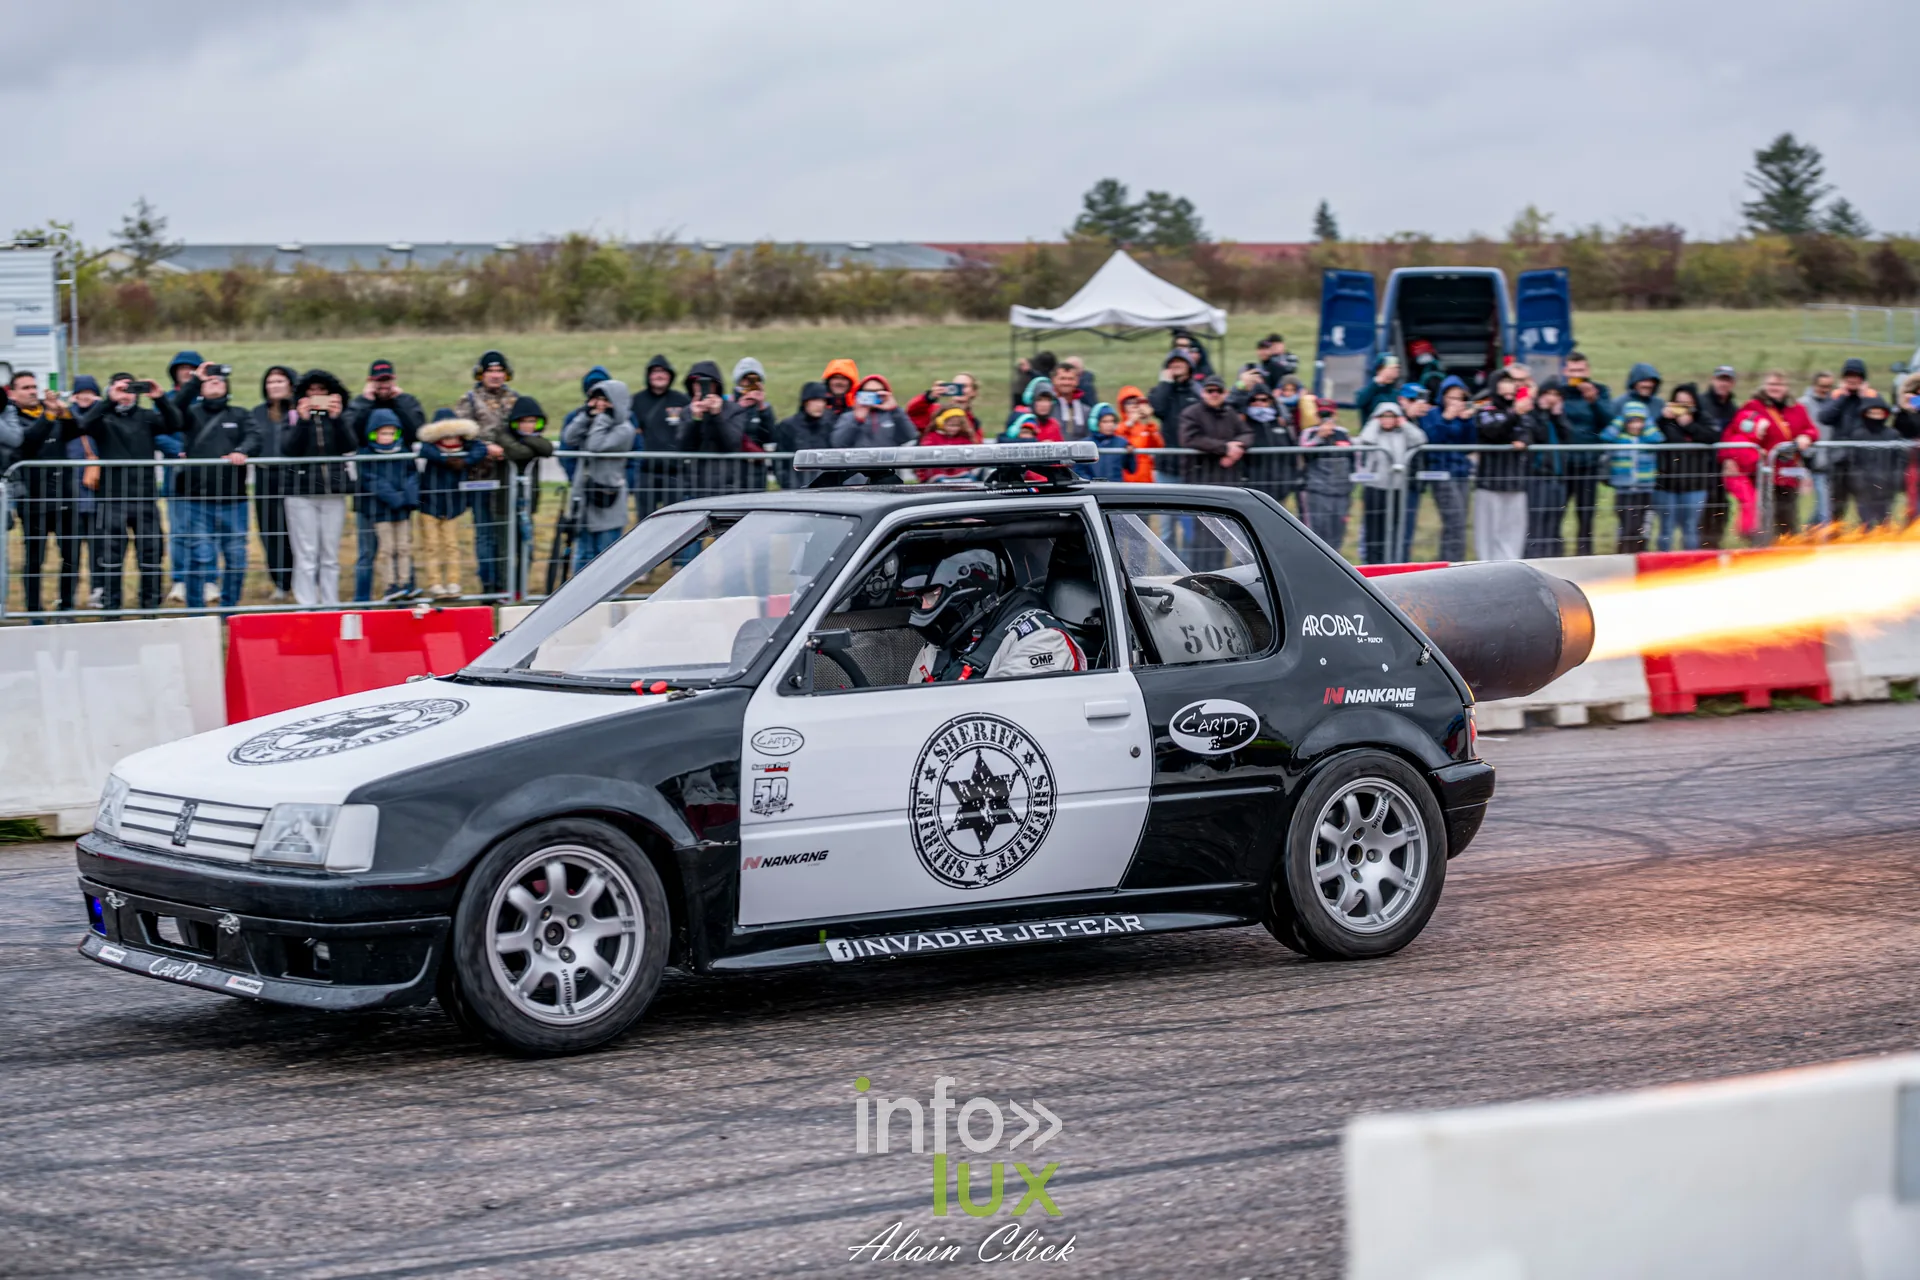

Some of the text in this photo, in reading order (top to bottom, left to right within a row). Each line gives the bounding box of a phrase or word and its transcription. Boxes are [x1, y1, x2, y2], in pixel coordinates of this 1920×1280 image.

[1179, 624, 1242, 655] 508
[1302, 614, 1368, 636] AROBAZ
[1030, 654, 1053, 666] OMP
[1345, 687, 1416, 703] NANKANG
[933, 721, 1024, 764] SHERIFF
[917, 790, 969, 878] SHERIFF
[995, 774, 1050, 874] SHERIFF
[761, 850, 829, 868] NANKANG
[852, 928, 1009, 958] INVADER
[1013, 915, 1146, 941] JET-CAR
